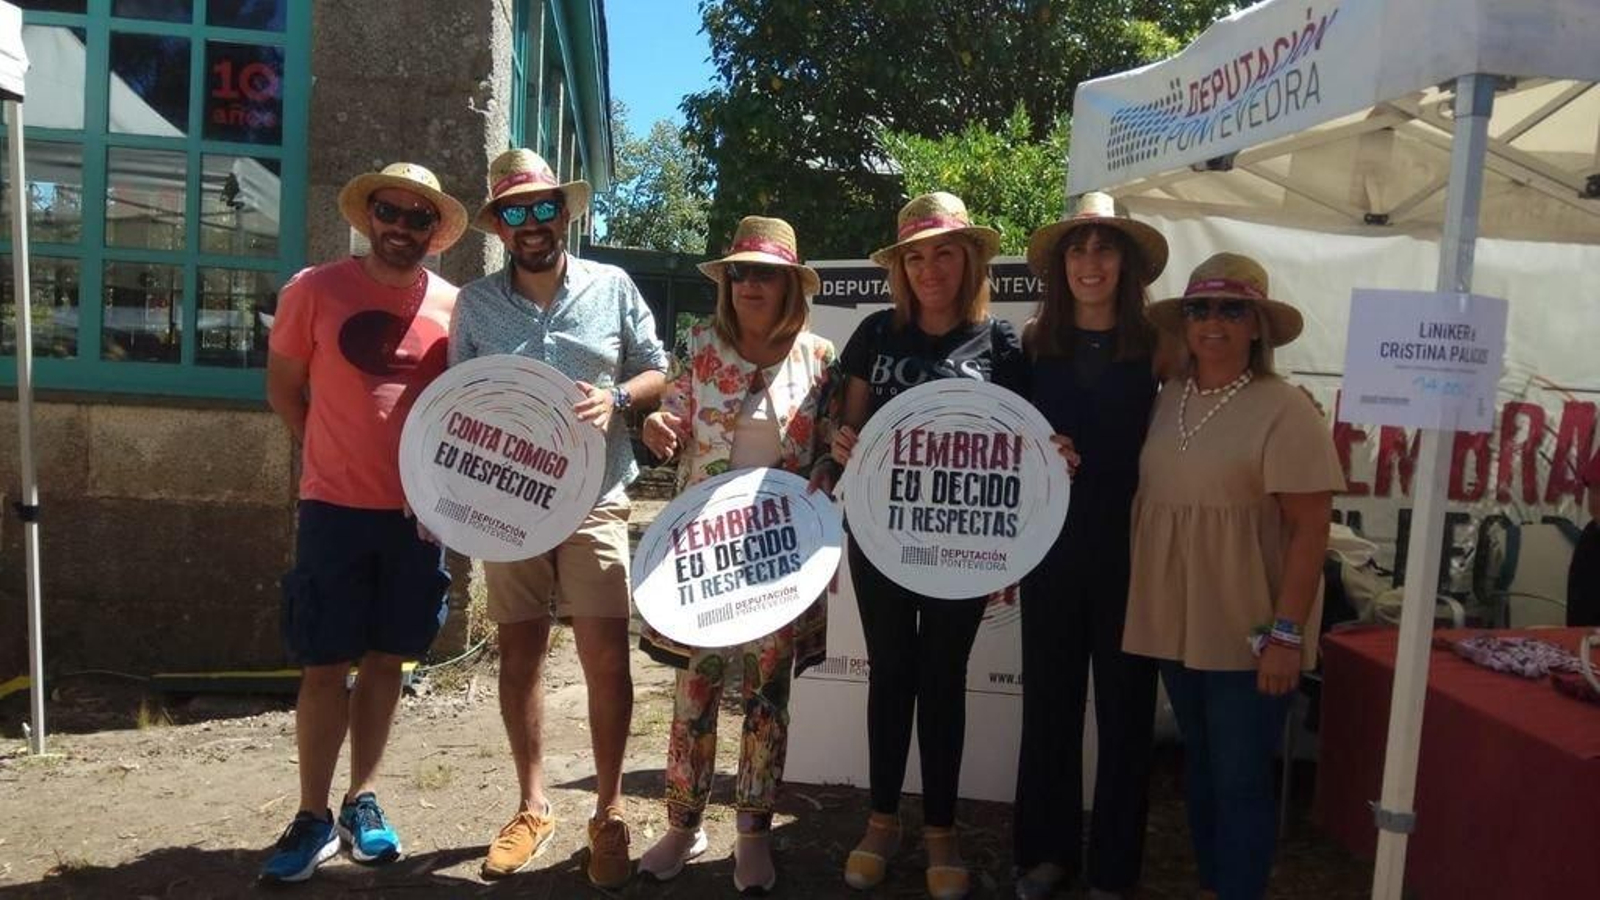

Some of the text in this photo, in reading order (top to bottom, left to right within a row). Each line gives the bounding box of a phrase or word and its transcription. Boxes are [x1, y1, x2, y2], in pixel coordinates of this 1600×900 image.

[212, 60, 278, 99] 10
[1185, 7, 1338, 118] DEPUTACIÓN
[1164, 61, 1321, 155] PONTEVEDRA
[823, 280, 891, 296] DEPUTA
[447, 411, 569, 480] CONTA COMIGO
[892, 428, 1022, 471] LEMBRA!
[434, 442, 557, 510] EU RESPÉCTOTE
[890, 469, 1021, 508] EU DECIDO
[468, 519, 525, 548] PONTEVEDRA
[470, 510, 527, 540] DEPUTACIÓN
[671, 495, 791, 556] LEMBRA!
[888, 505, 1018, 538] TI RESPECTAS
[675, 526, 797, 583] EU DECIDO
[940, 558, 1007, 571] PONTEVEDRA
[941, 549, 1007, 562] DEPUTACIÓN
[677, 585, 695, 606] TI
[701, 553, 801, 599] RESPECTAS
[735, 585, 798, 610] DEPUTACIÓN
